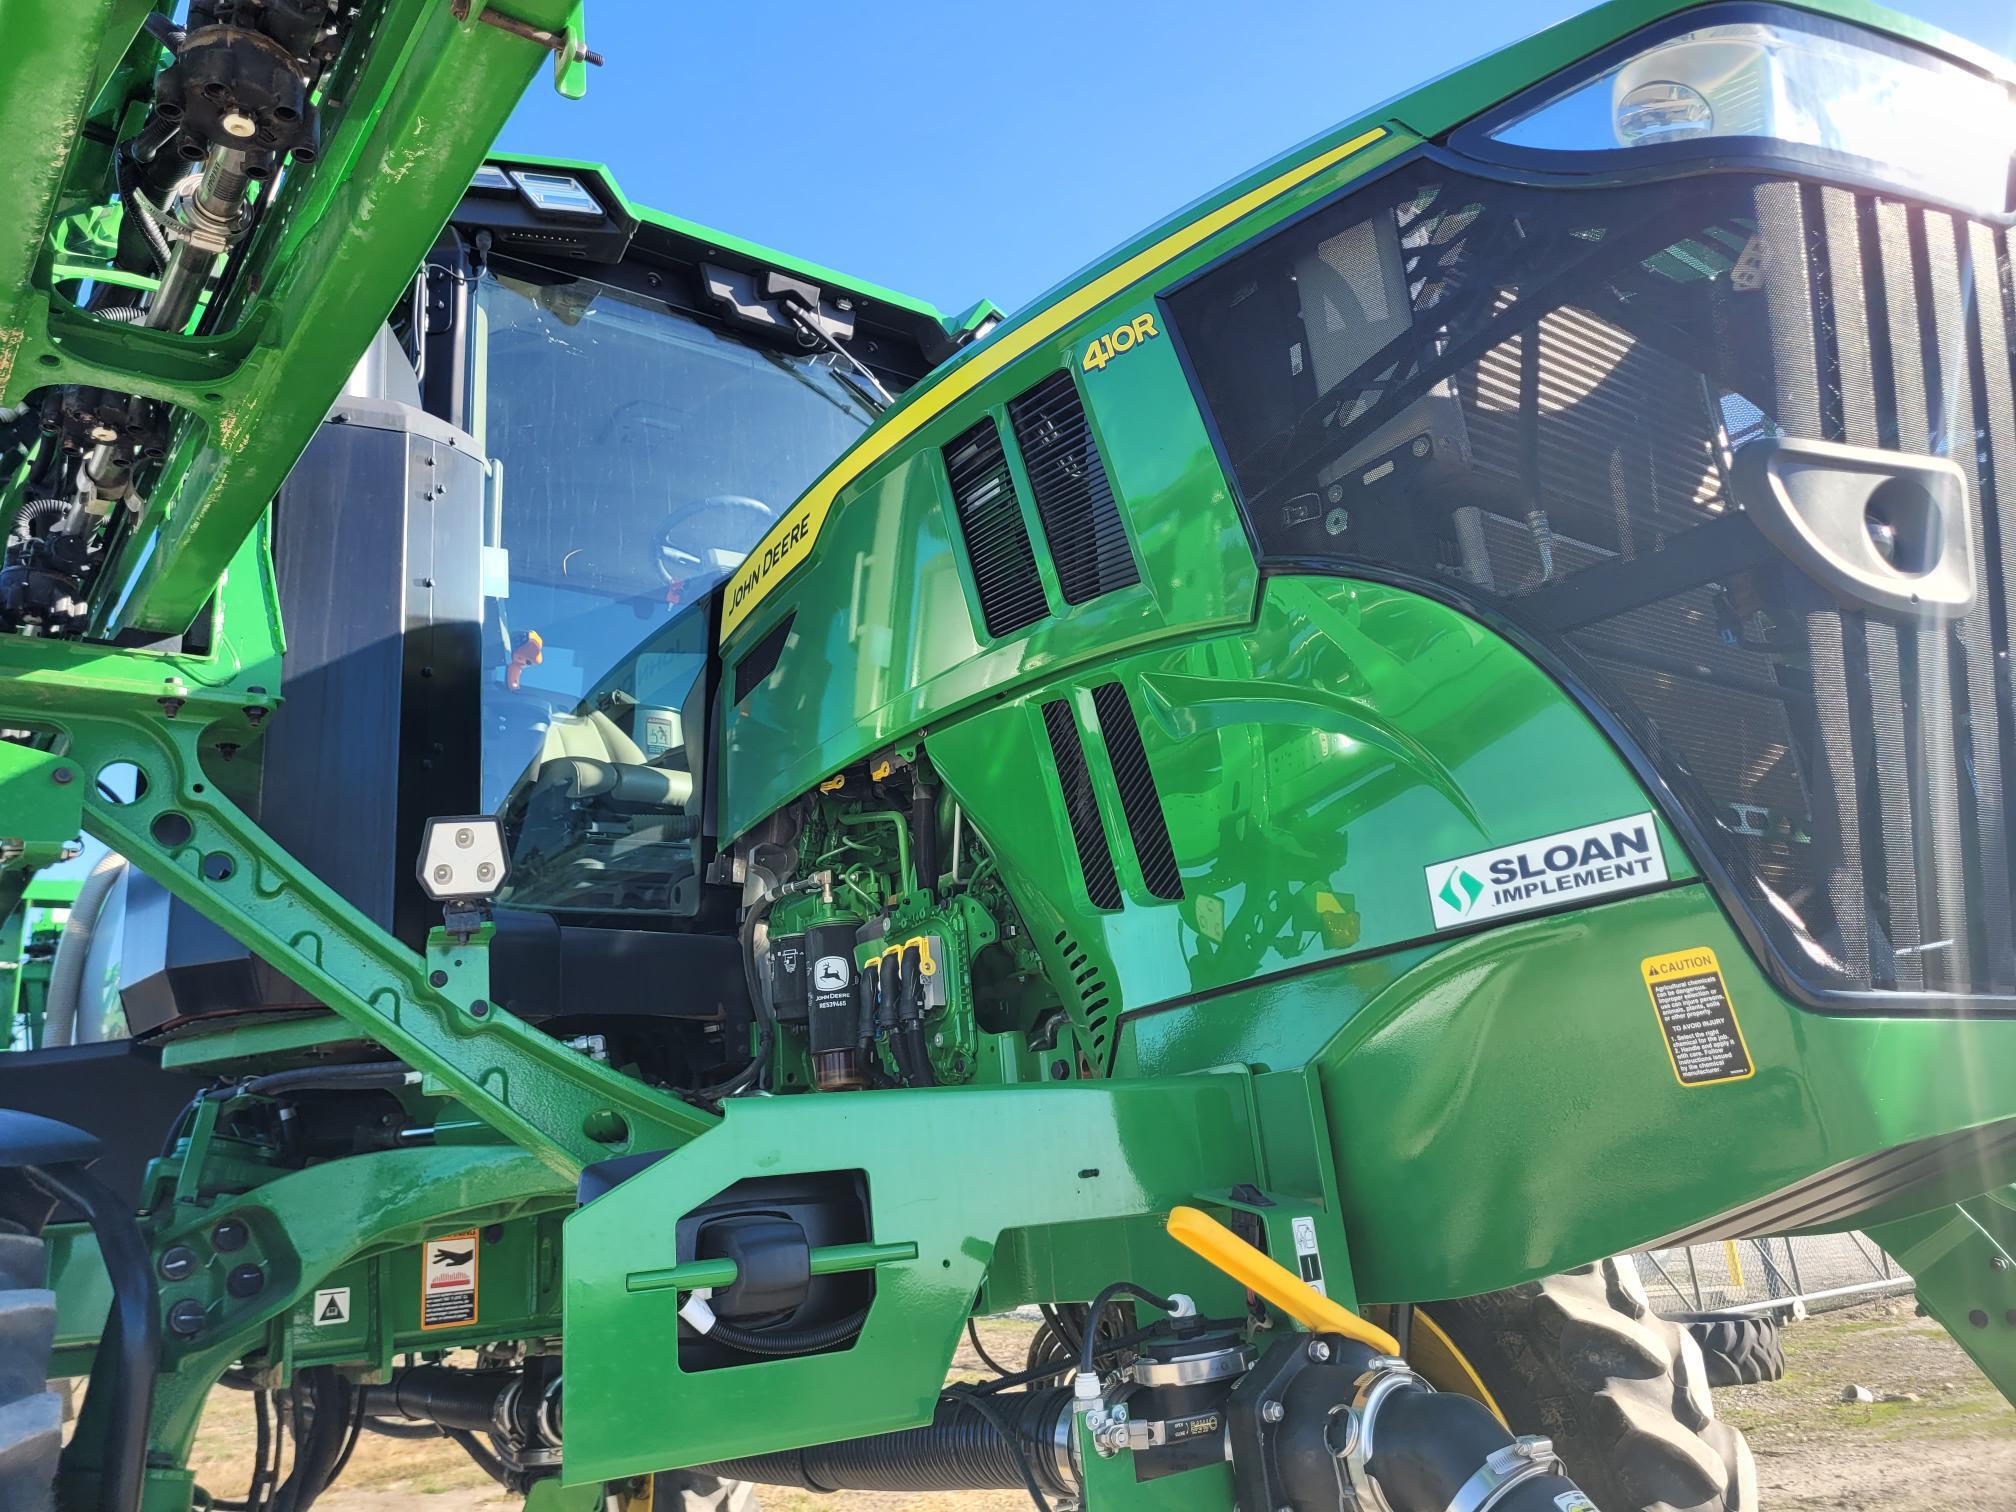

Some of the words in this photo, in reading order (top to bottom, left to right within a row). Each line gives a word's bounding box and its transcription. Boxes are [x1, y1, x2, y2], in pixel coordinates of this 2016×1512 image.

[1082, 313, 1160, 373] 410R
[728, 564, 761, 616] JOHN
[762, 512, 810, 577] DEERE
[1489, 826, 1650, 885] SLOAN
[1494, 857, 1653, 905] IMPLEMENT
[1660, 955, 1712, 974] CAUTION
[1682, 1021, 1702, 1031] AVOID
[1702, 1018, 1725, 1027] INJURY
